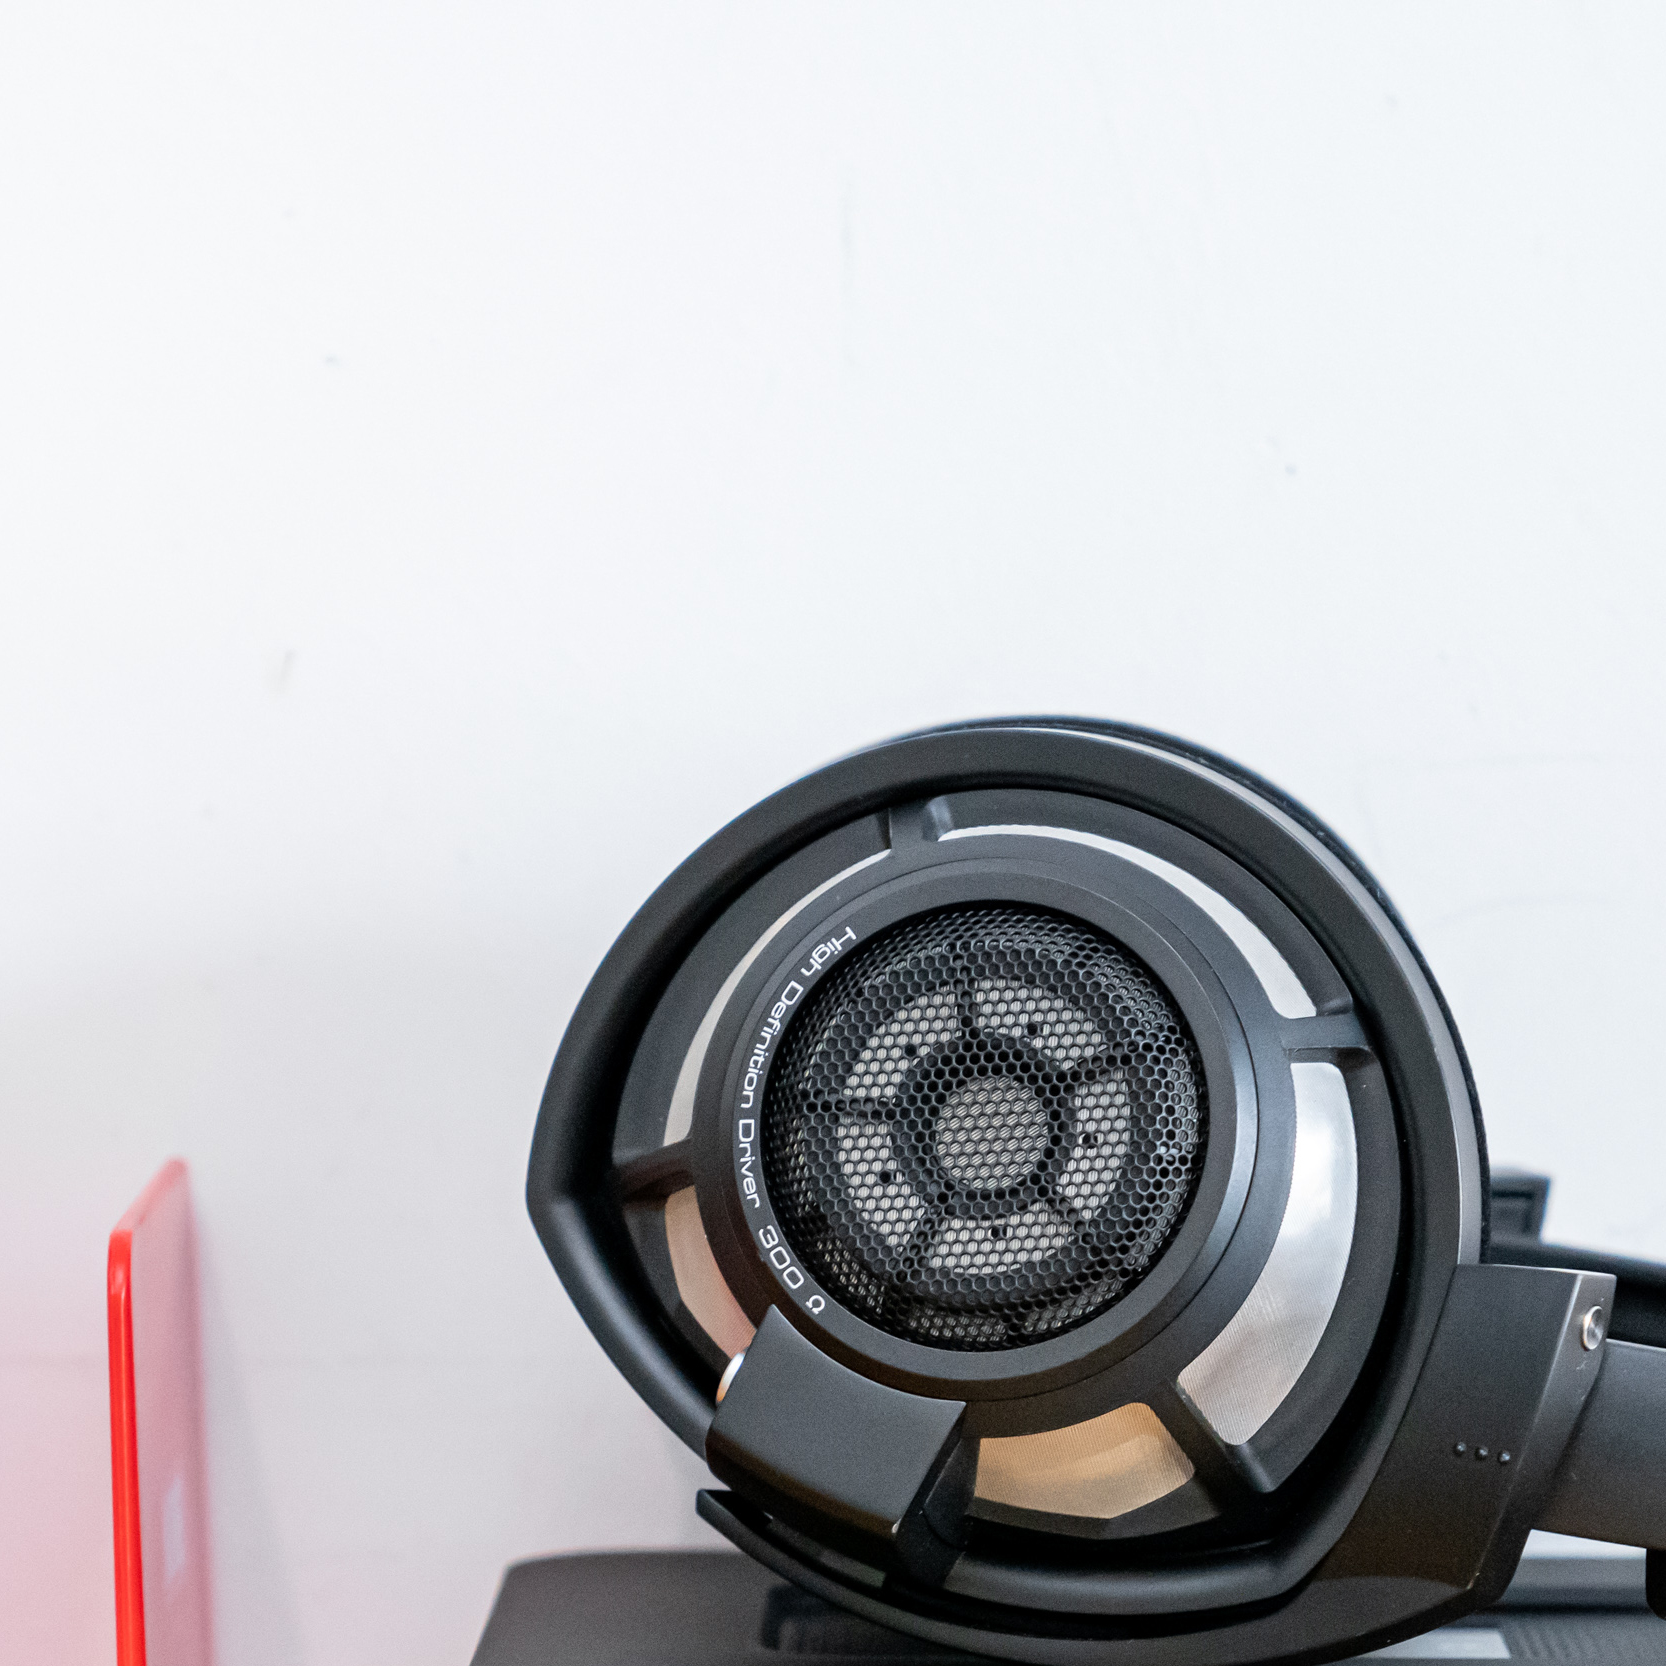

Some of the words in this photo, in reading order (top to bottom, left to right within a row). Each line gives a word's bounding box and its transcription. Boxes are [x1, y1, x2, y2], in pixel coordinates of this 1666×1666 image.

[800, 926, 857, 976] High
[740, 980, 804, 1108] Definition
[738, 1119, 760, 1208] Driver
[759, 1225, 804, 1289] 300
